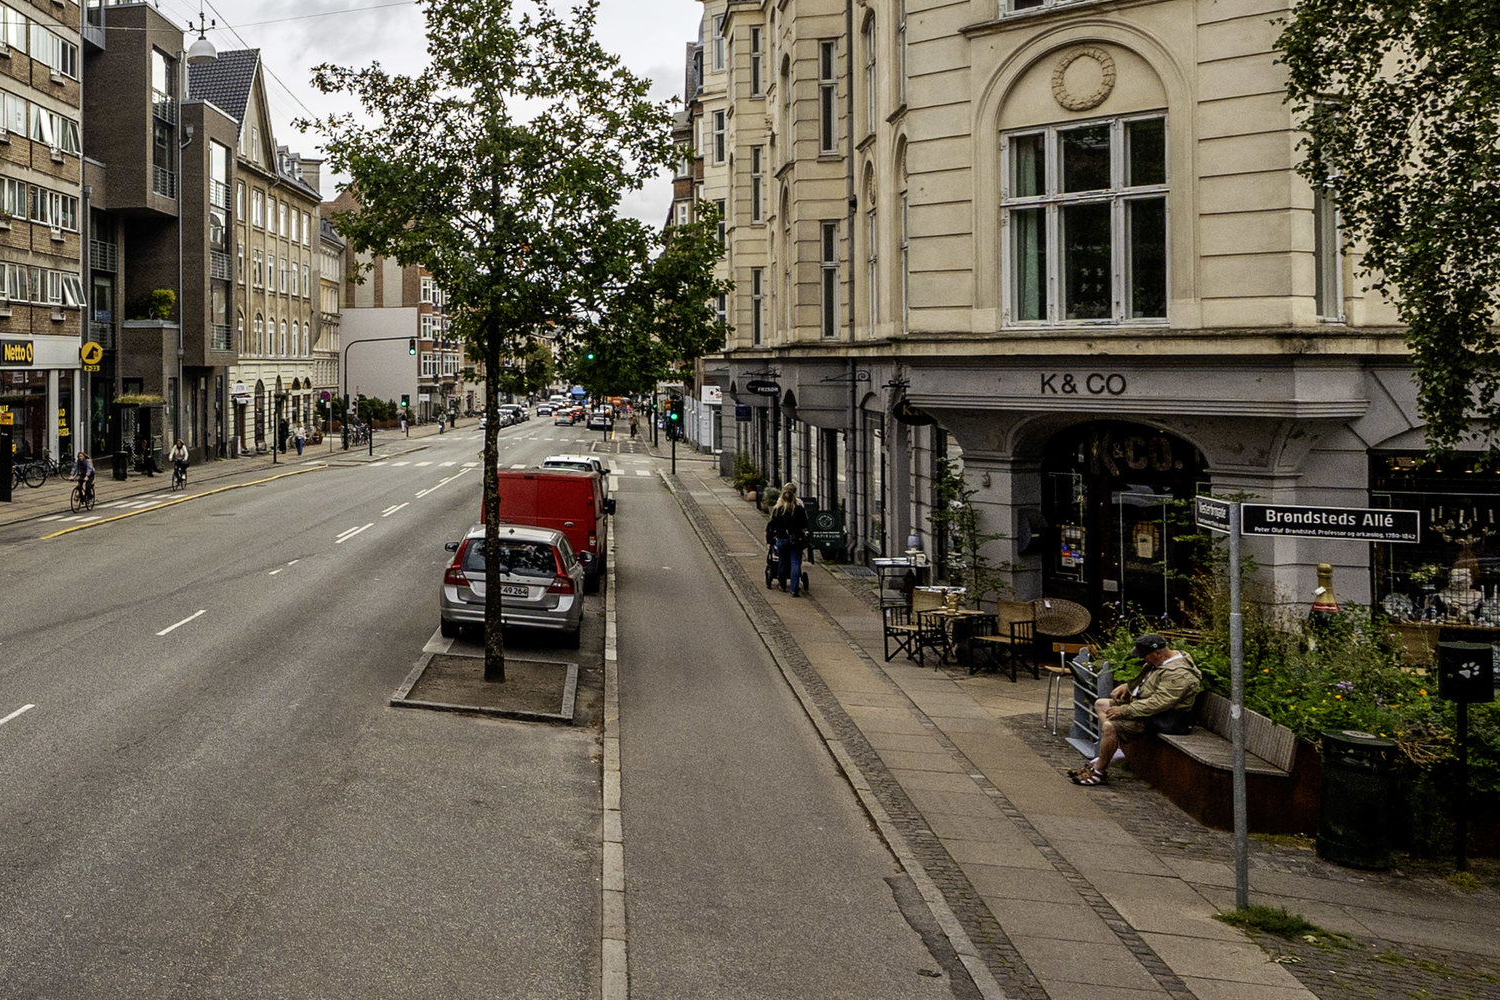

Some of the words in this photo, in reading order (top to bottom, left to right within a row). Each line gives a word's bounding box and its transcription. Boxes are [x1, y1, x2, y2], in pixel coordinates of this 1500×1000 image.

[4, 343, 26, 361] Netto
[1086, 372, 1128, 396] CO
[1265, 509, 1357, 526] Brøndsteds
[1362, 513, 1394, 527] Allé
[1318, 529, 1347, 537] Professor
